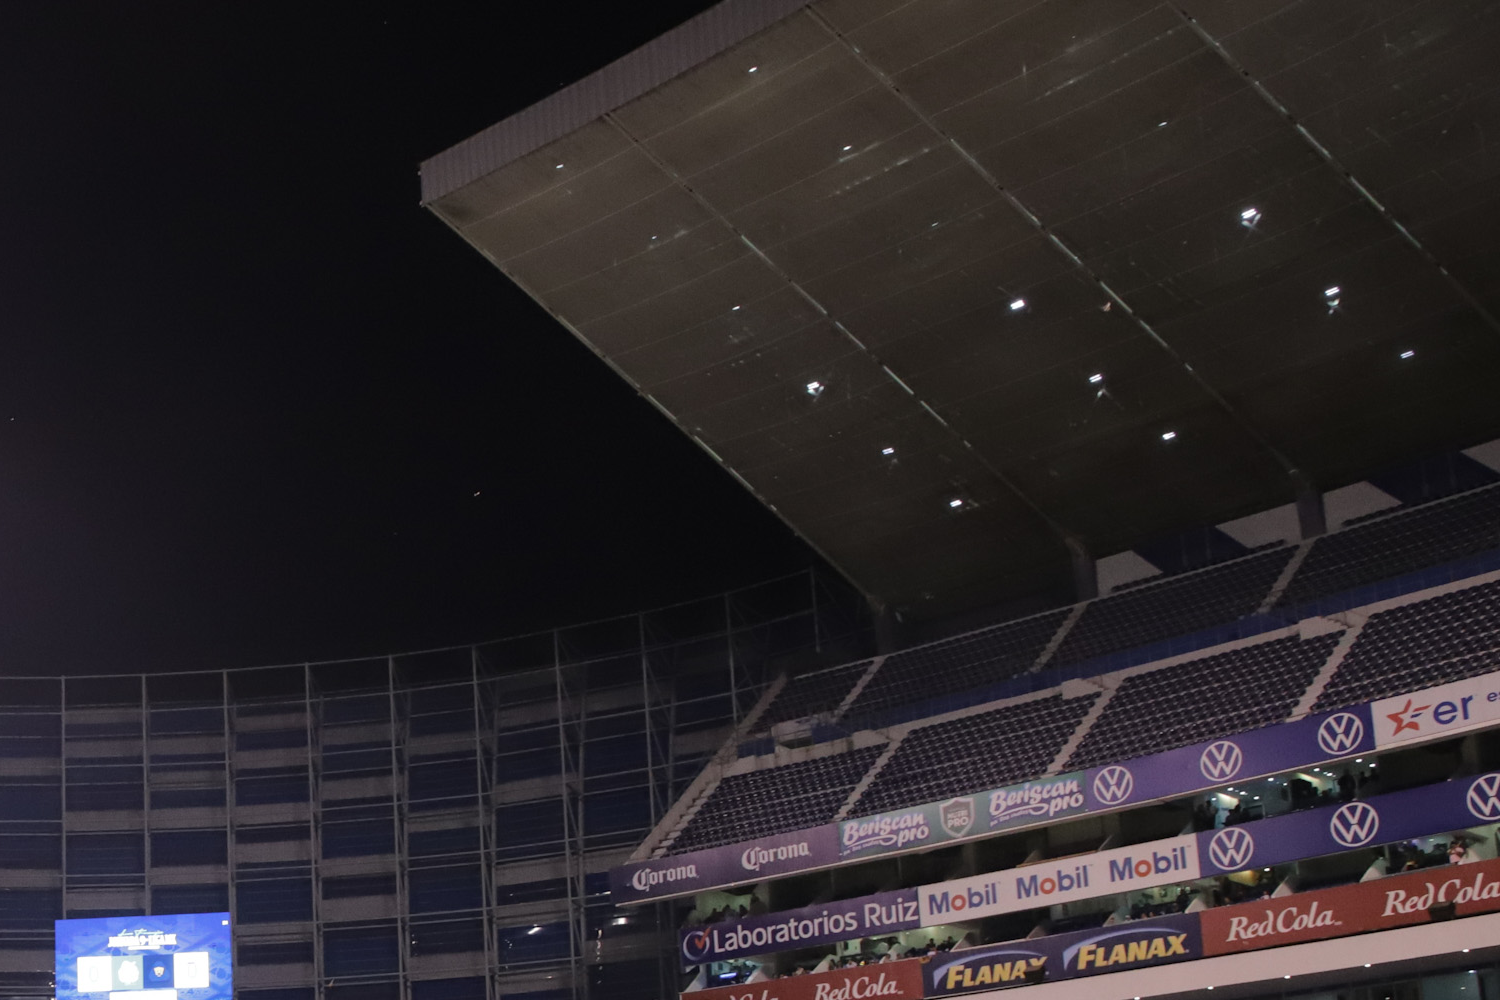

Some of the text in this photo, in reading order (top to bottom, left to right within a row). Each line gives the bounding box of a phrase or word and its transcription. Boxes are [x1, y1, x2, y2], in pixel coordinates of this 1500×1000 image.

[1433, 691, 1500, 725] er e
[990, 779, 1079, 817] Beriscan
[1050, 792, 1084, 816] pro
[843, 813, 925, 845] Beriscan
[897, 826, 929, 847] pro
[947, 817, 969, 828] PRO
[742, 842, 809, 871] Corona
[1109, 847, 1187, 882] Mobil
[632, 864, 697, 891] Corona
[1016, 865, 1089, 899] Mobil
[929, 882, 997, 915] Mobil
[713, 898, 920, 953] Laboratorios Ruiz
[1077, 934, 1187, 970] FLANAX
